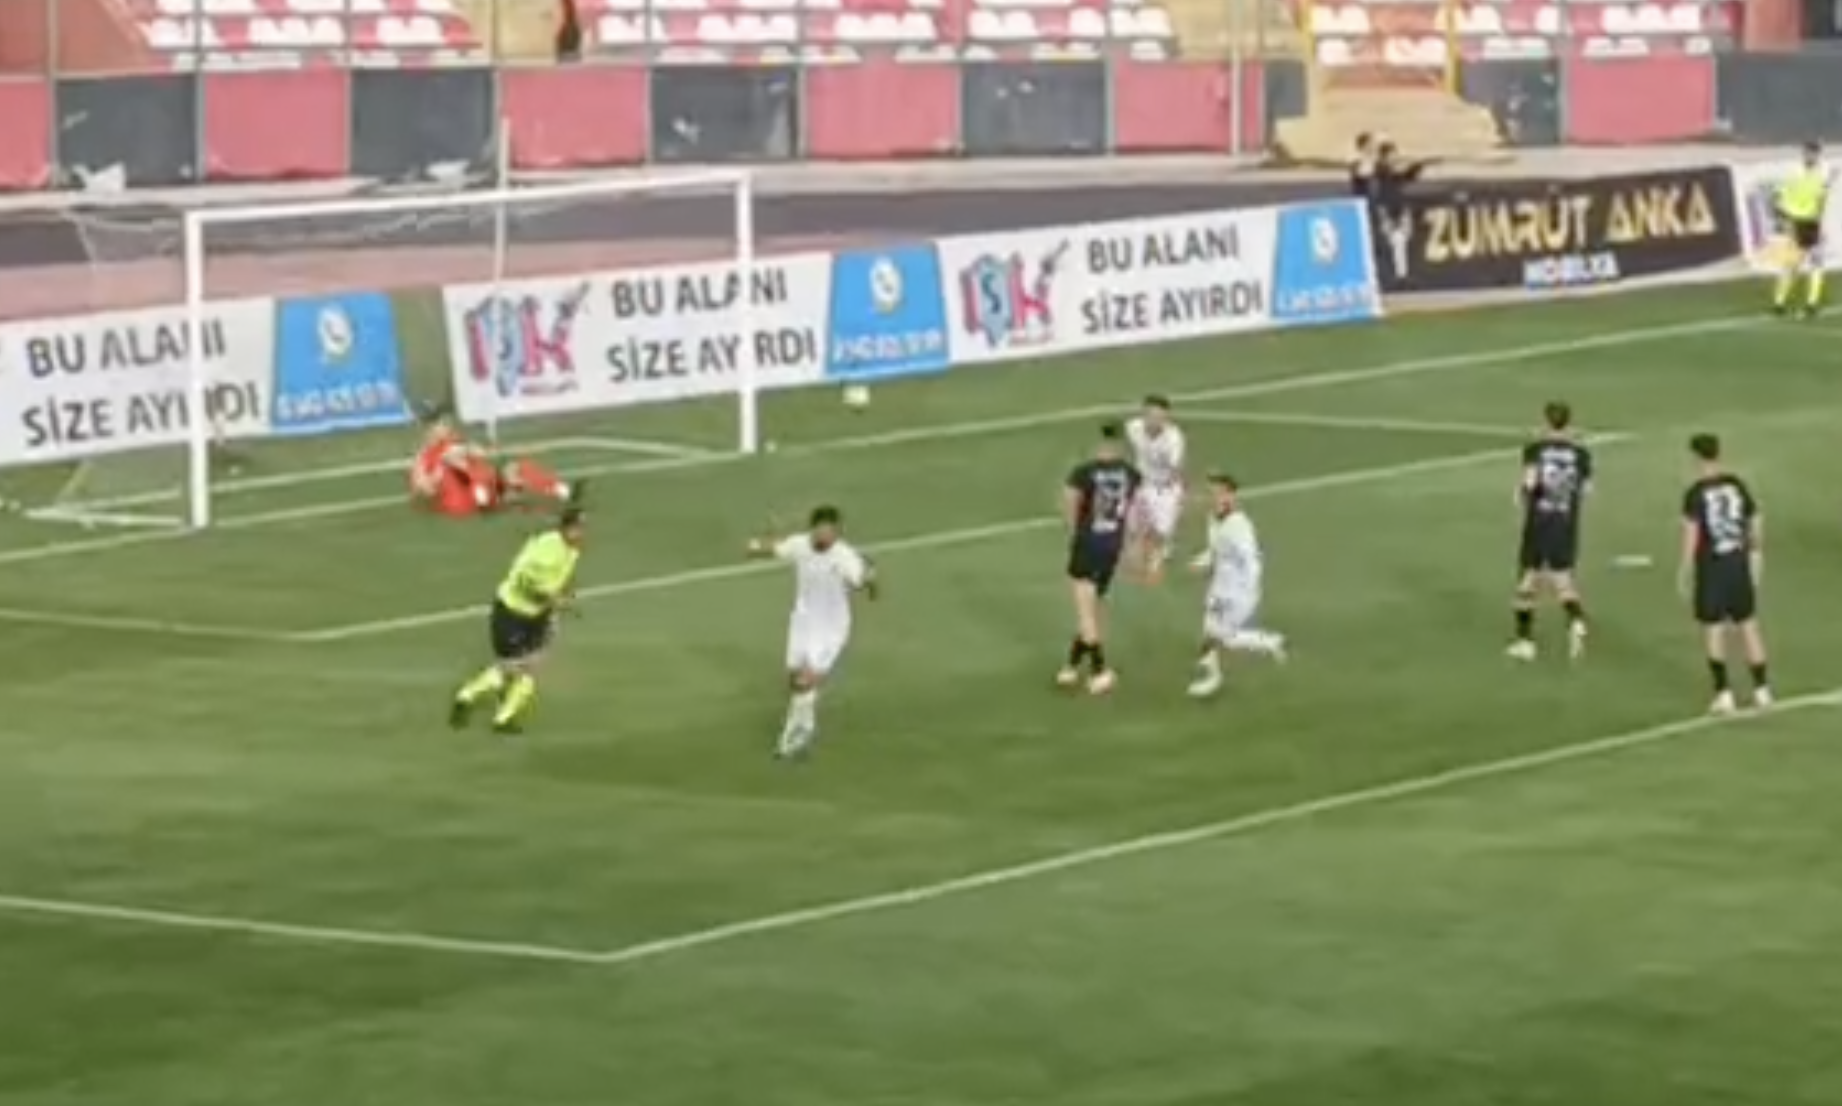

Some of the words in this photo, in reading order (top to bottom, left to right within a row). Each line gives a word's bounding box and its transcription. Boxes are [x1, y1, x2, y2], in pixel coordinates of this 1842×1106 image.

[1606, 181, 1717, 243] ANKA
[1087, 238, 1133, 274] BU
[1143, 225, 1239, 268] ALANI
[612, 277, 663, 319] BU
[1080, 290, 1150, 335] SİZE
[1160, 279, 1263, 324] AYIRDI
[26, 333, 85, 378] BU
[607, 335, 689, 383] SİZE
[699, 327, 818, 374] AYRDI
[20, 394, 115, 447] SİZE
